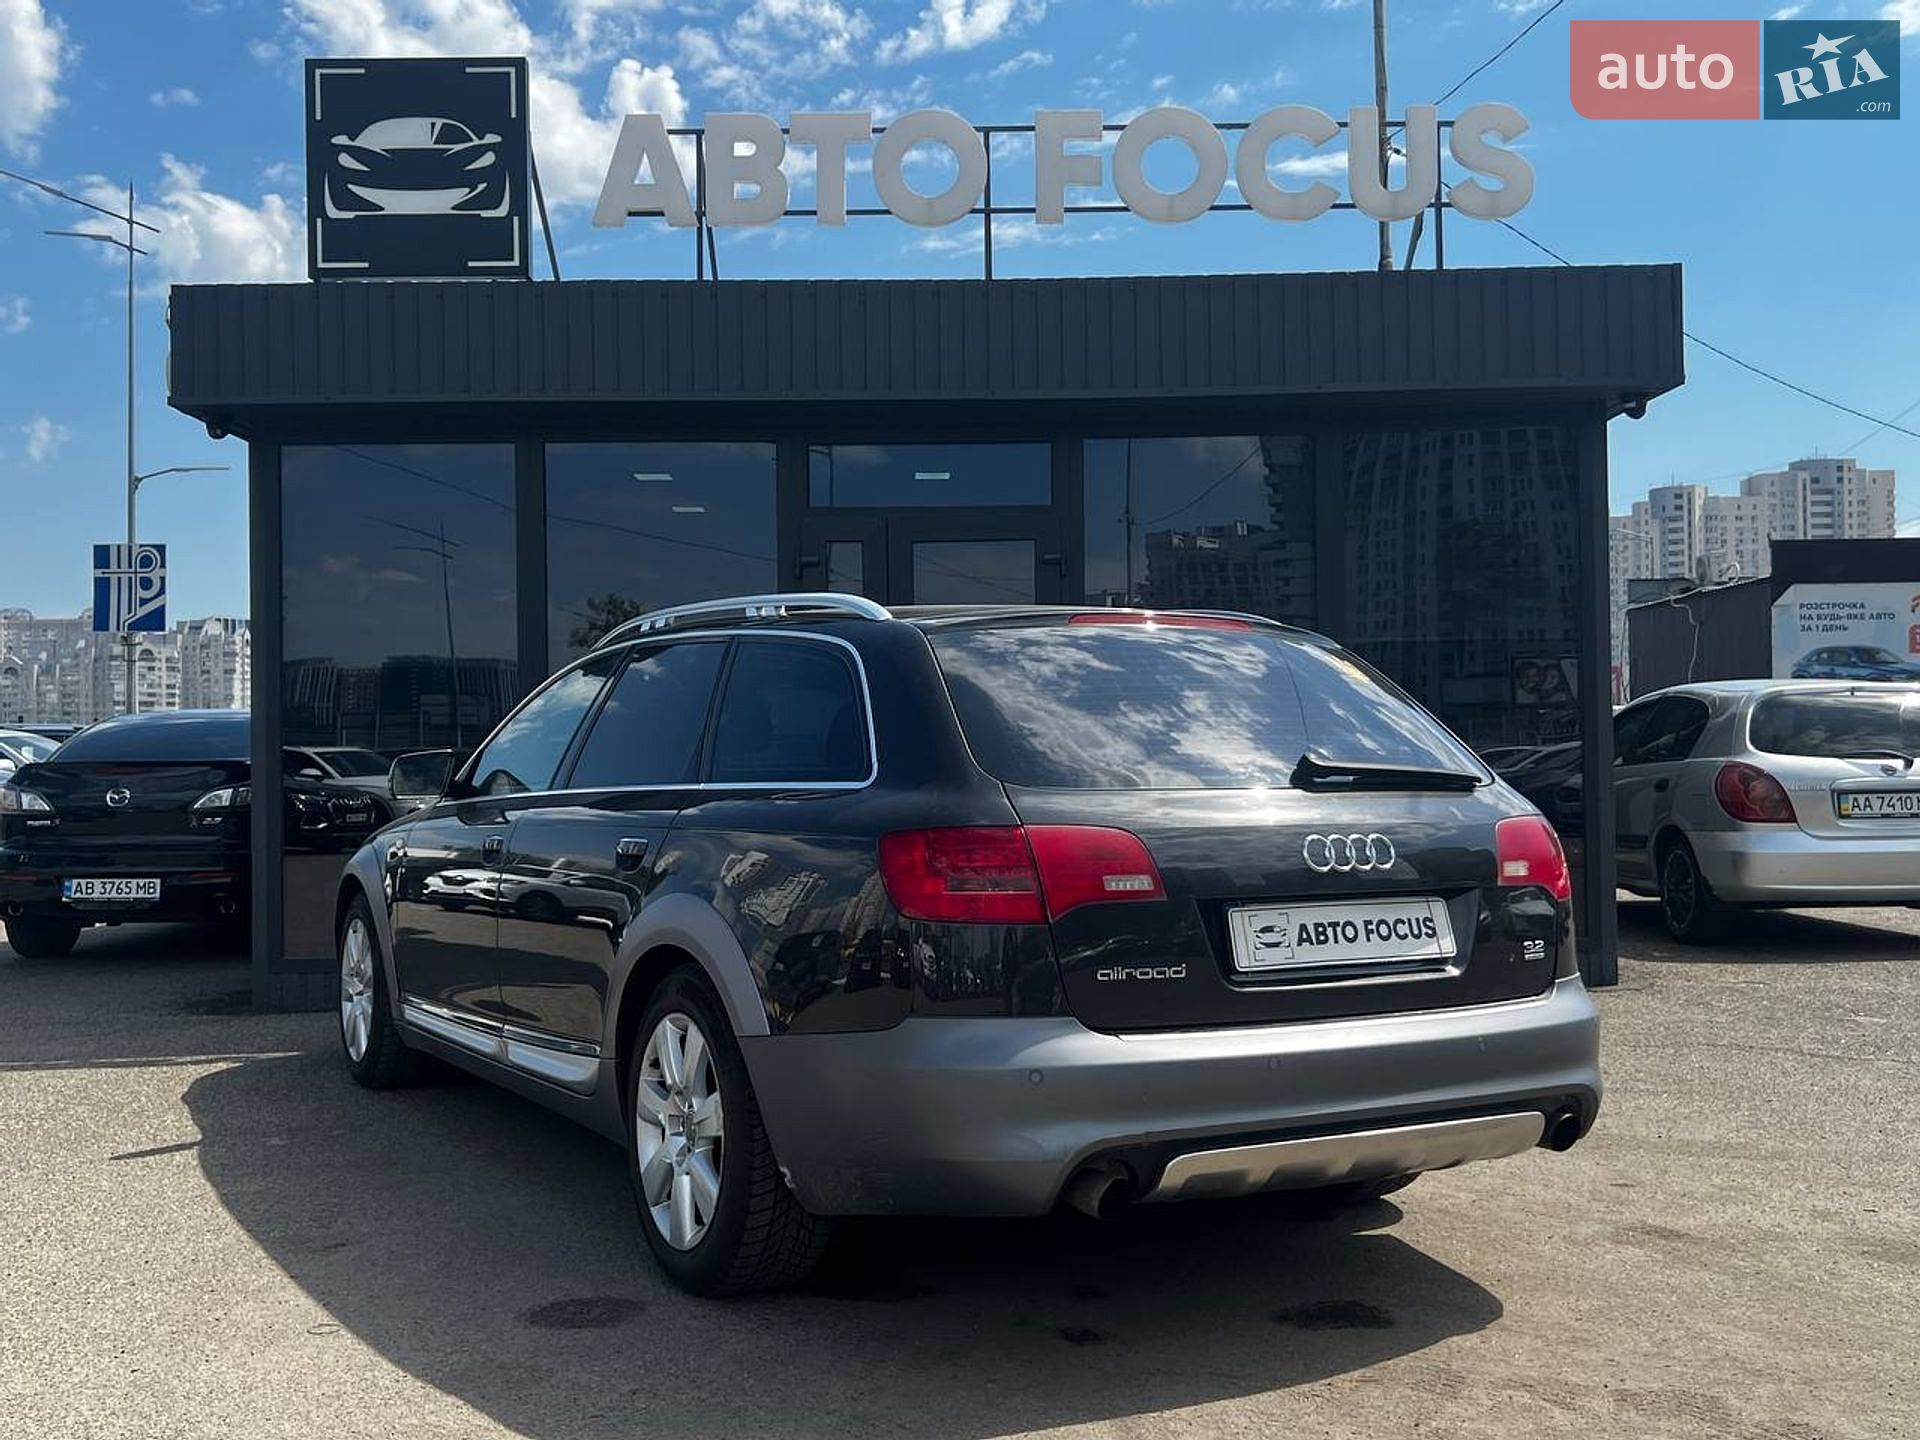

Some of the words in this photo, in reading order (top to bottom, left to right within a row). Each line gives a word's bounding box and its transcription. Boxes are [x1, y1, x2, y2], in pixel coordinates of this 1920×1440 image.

[591, 108, 988, 229] АВТО
[1034, 102, 1537, 225] FOCUS
[1800, 602, 1866, 611] РОЗСТРОЧКА
[1800, 613, 1814, 621] НА
[1868, 612, 1896, 621] АВТО
[1800, 624, 1813, 632] ЗА
[1822, 624, 1849, 633] ДЕНЬ
[1851, 797, 1874, 812] AA
[1876, 795, 1914, 812] 7410
[73, 881, 95, 896] AB
[99, 880, 133, 896] 3765
[136, 880, 157, 896] MB
[1296, 919, 1359, 947] АВТО
[1364, 916, 1438, 943] FOCUS
[1096, 963, 1187, 981] allroad
